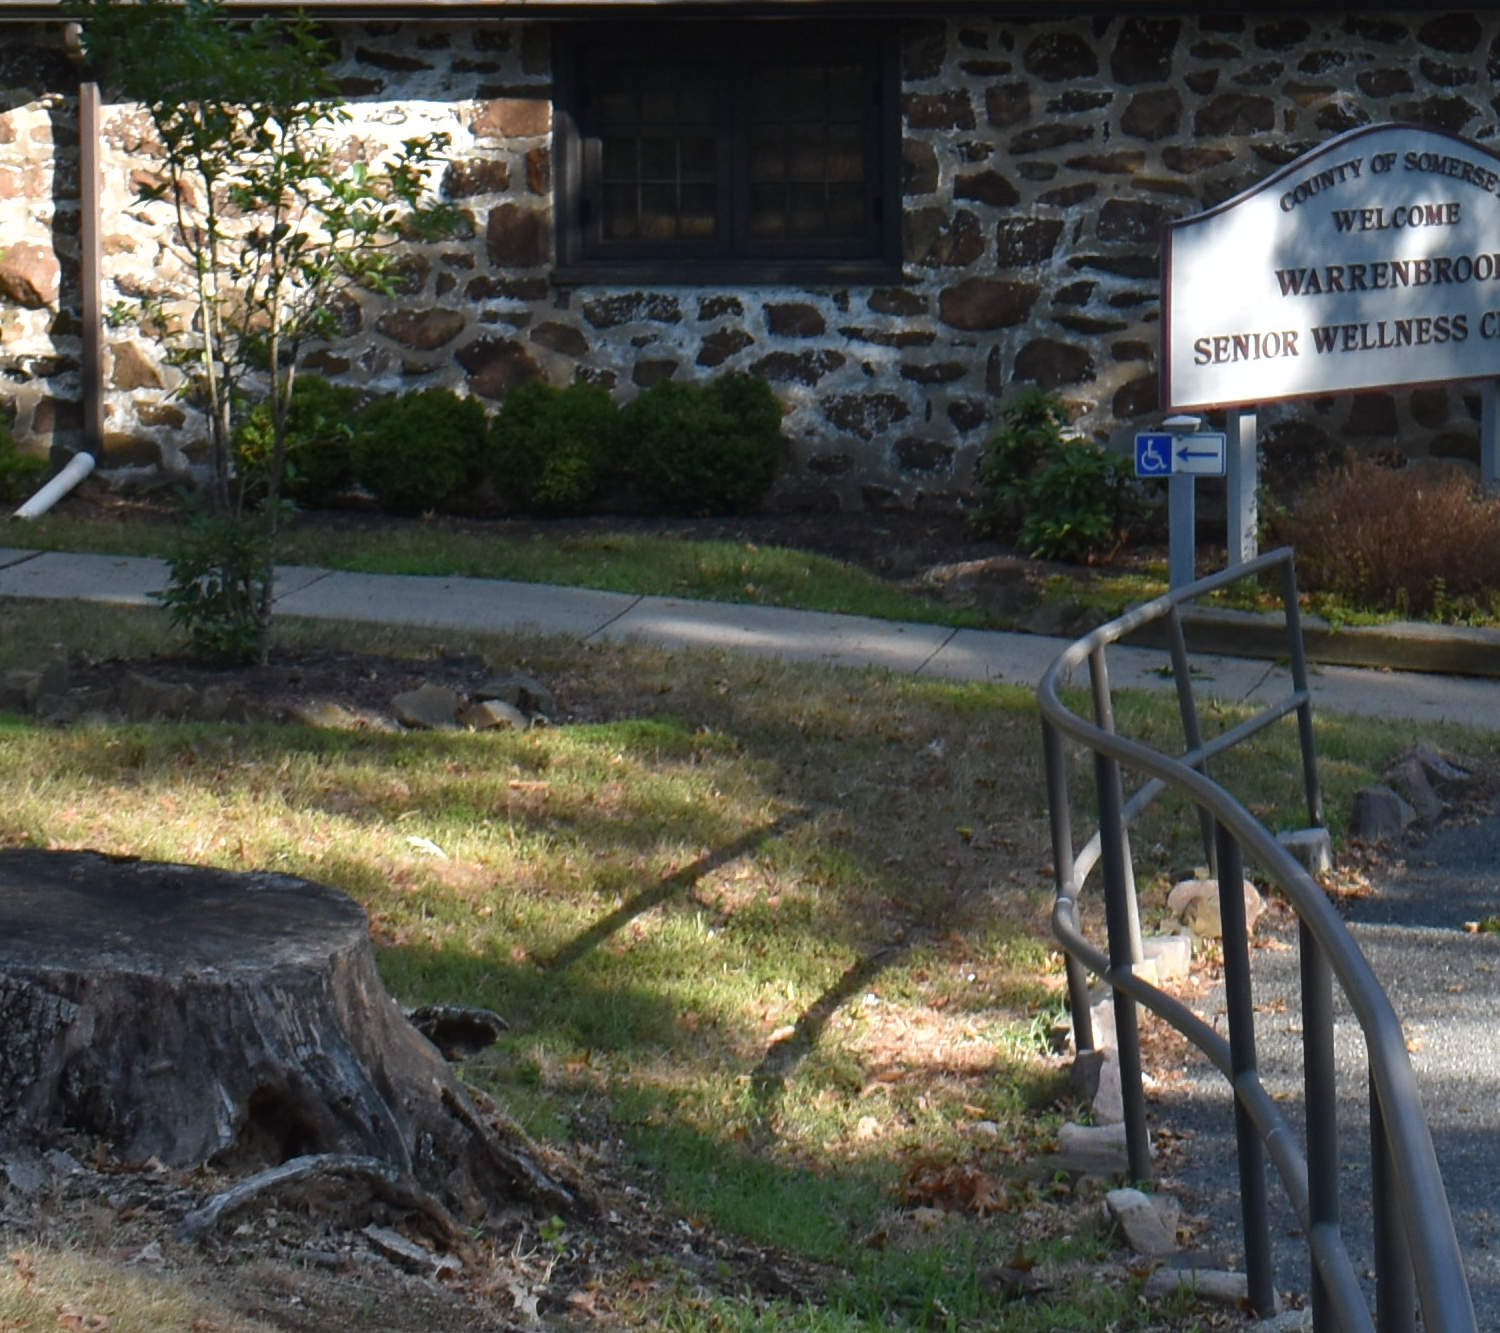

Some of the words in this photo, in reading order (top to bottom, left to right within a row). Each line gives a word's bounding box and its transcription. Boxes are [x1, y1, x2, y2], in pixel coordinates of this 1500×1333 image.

[1279, 157, 1363, 213] COUNTY
[1370, 152, 1398, 173] OF
[1332, 202, 1461, 233] WELCOME
[1193, 330, 1300, 366] SENIOR
[1311, 314, 1469, 354] WELLNESS
